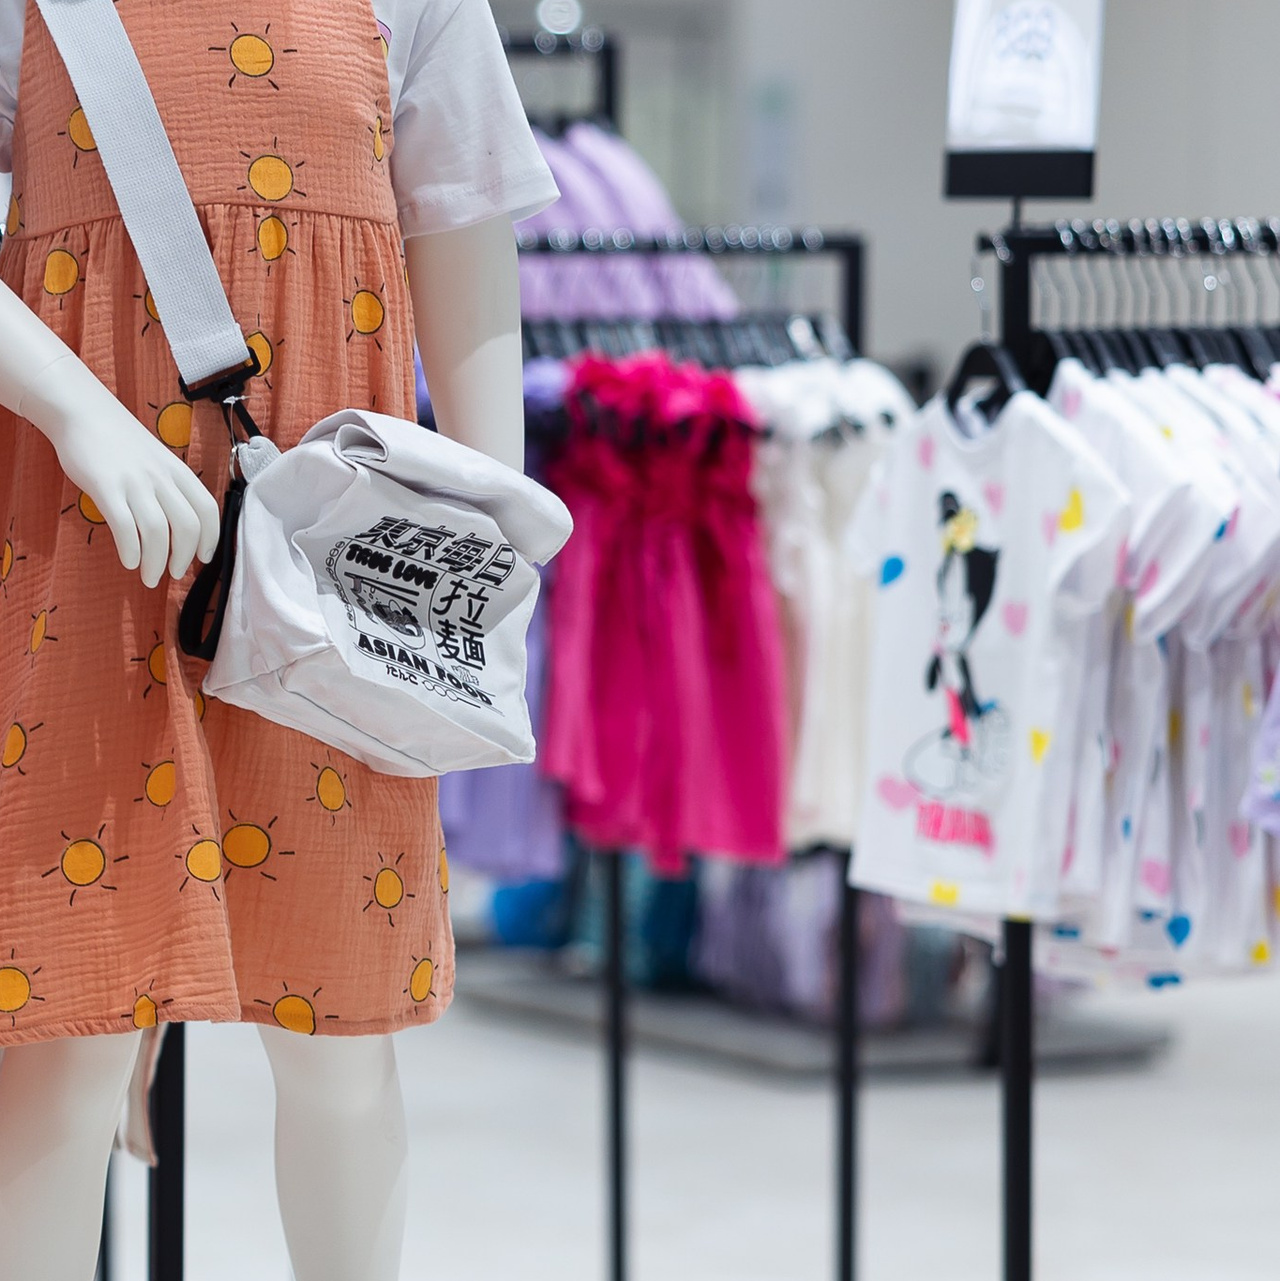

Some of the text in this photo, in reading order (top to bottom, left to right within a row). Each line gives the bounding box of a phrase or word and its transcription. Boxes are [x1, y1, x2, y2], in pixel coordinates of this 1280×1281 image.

[346, 543, 438, 589] TRUE LOVE
[358, 633, 493, 705] ASIAN FOOD
